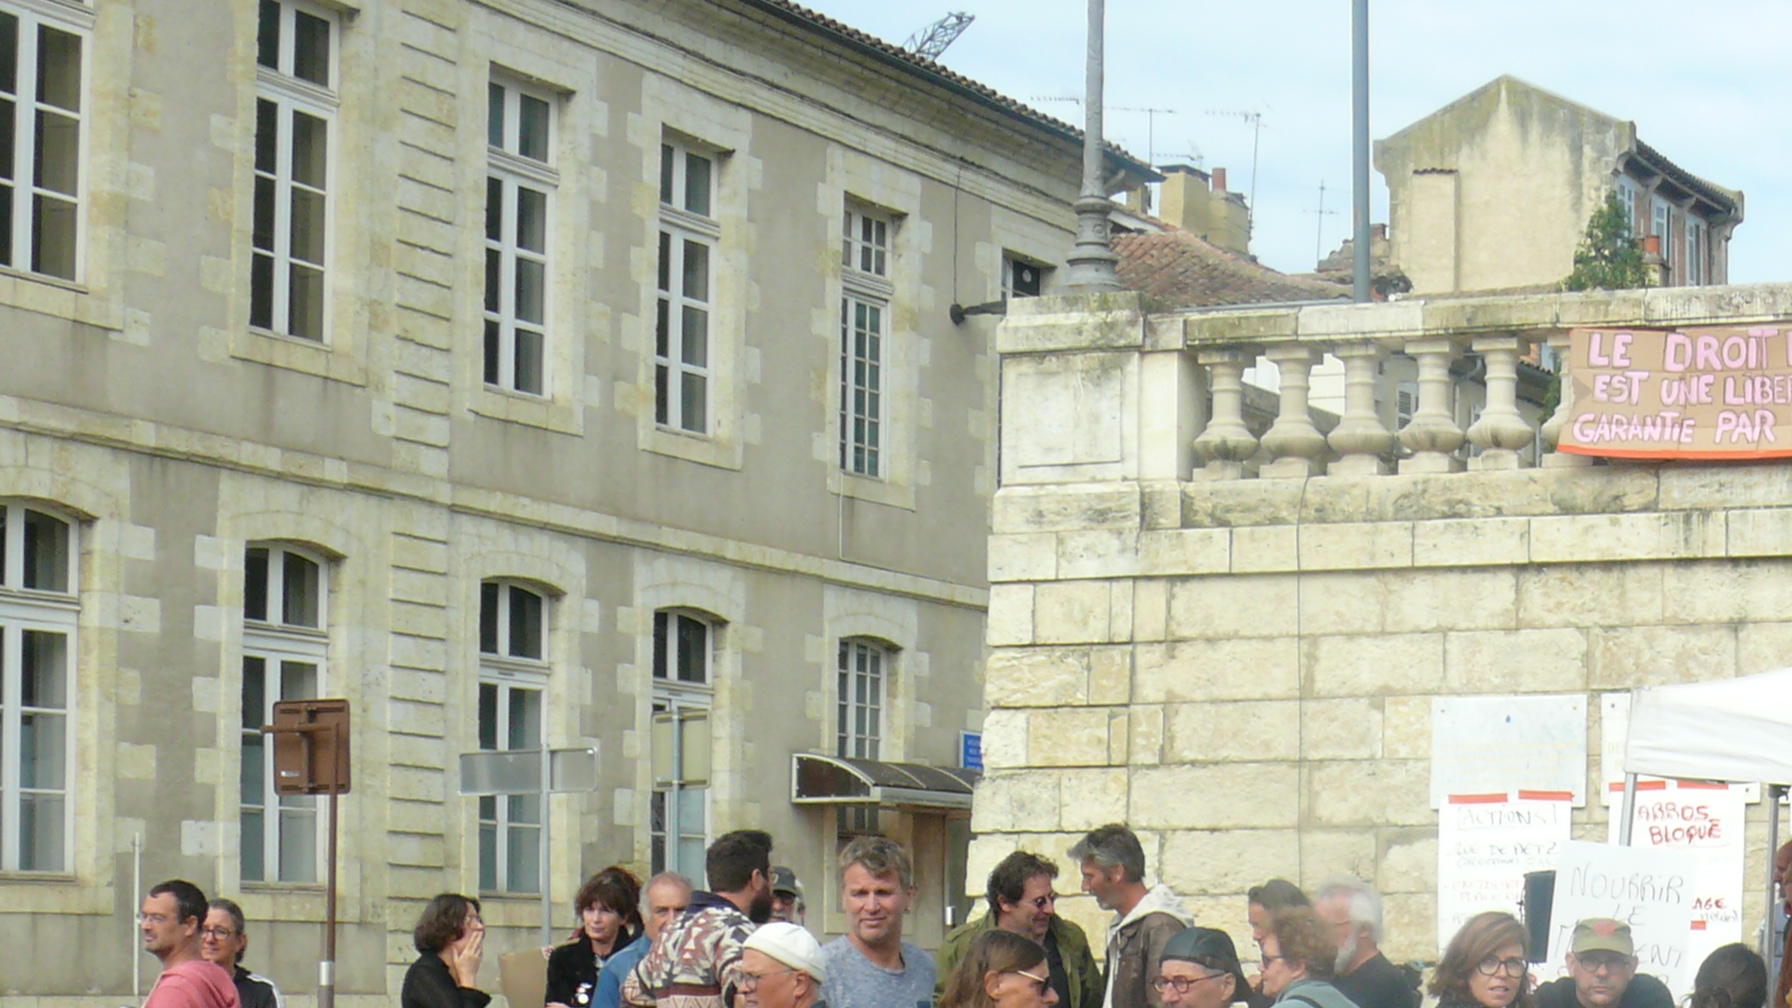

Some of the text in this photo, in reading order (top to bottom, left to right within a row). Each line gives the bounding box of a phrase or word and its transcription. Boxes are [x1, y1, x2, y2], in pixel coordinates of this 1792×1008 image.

[1587, 332, 1634, 368] LE
[1662, 327, 1779, 372] DROIT
[1592, 370, 1650, 406] EST
[1659, 375, 1715, 406] UNE
[1572, 410, 1697, 444] GARANTIE
[1714, 408, 1777, 445] PAR
[1570, 861, 1684, 904] NOURRIR
